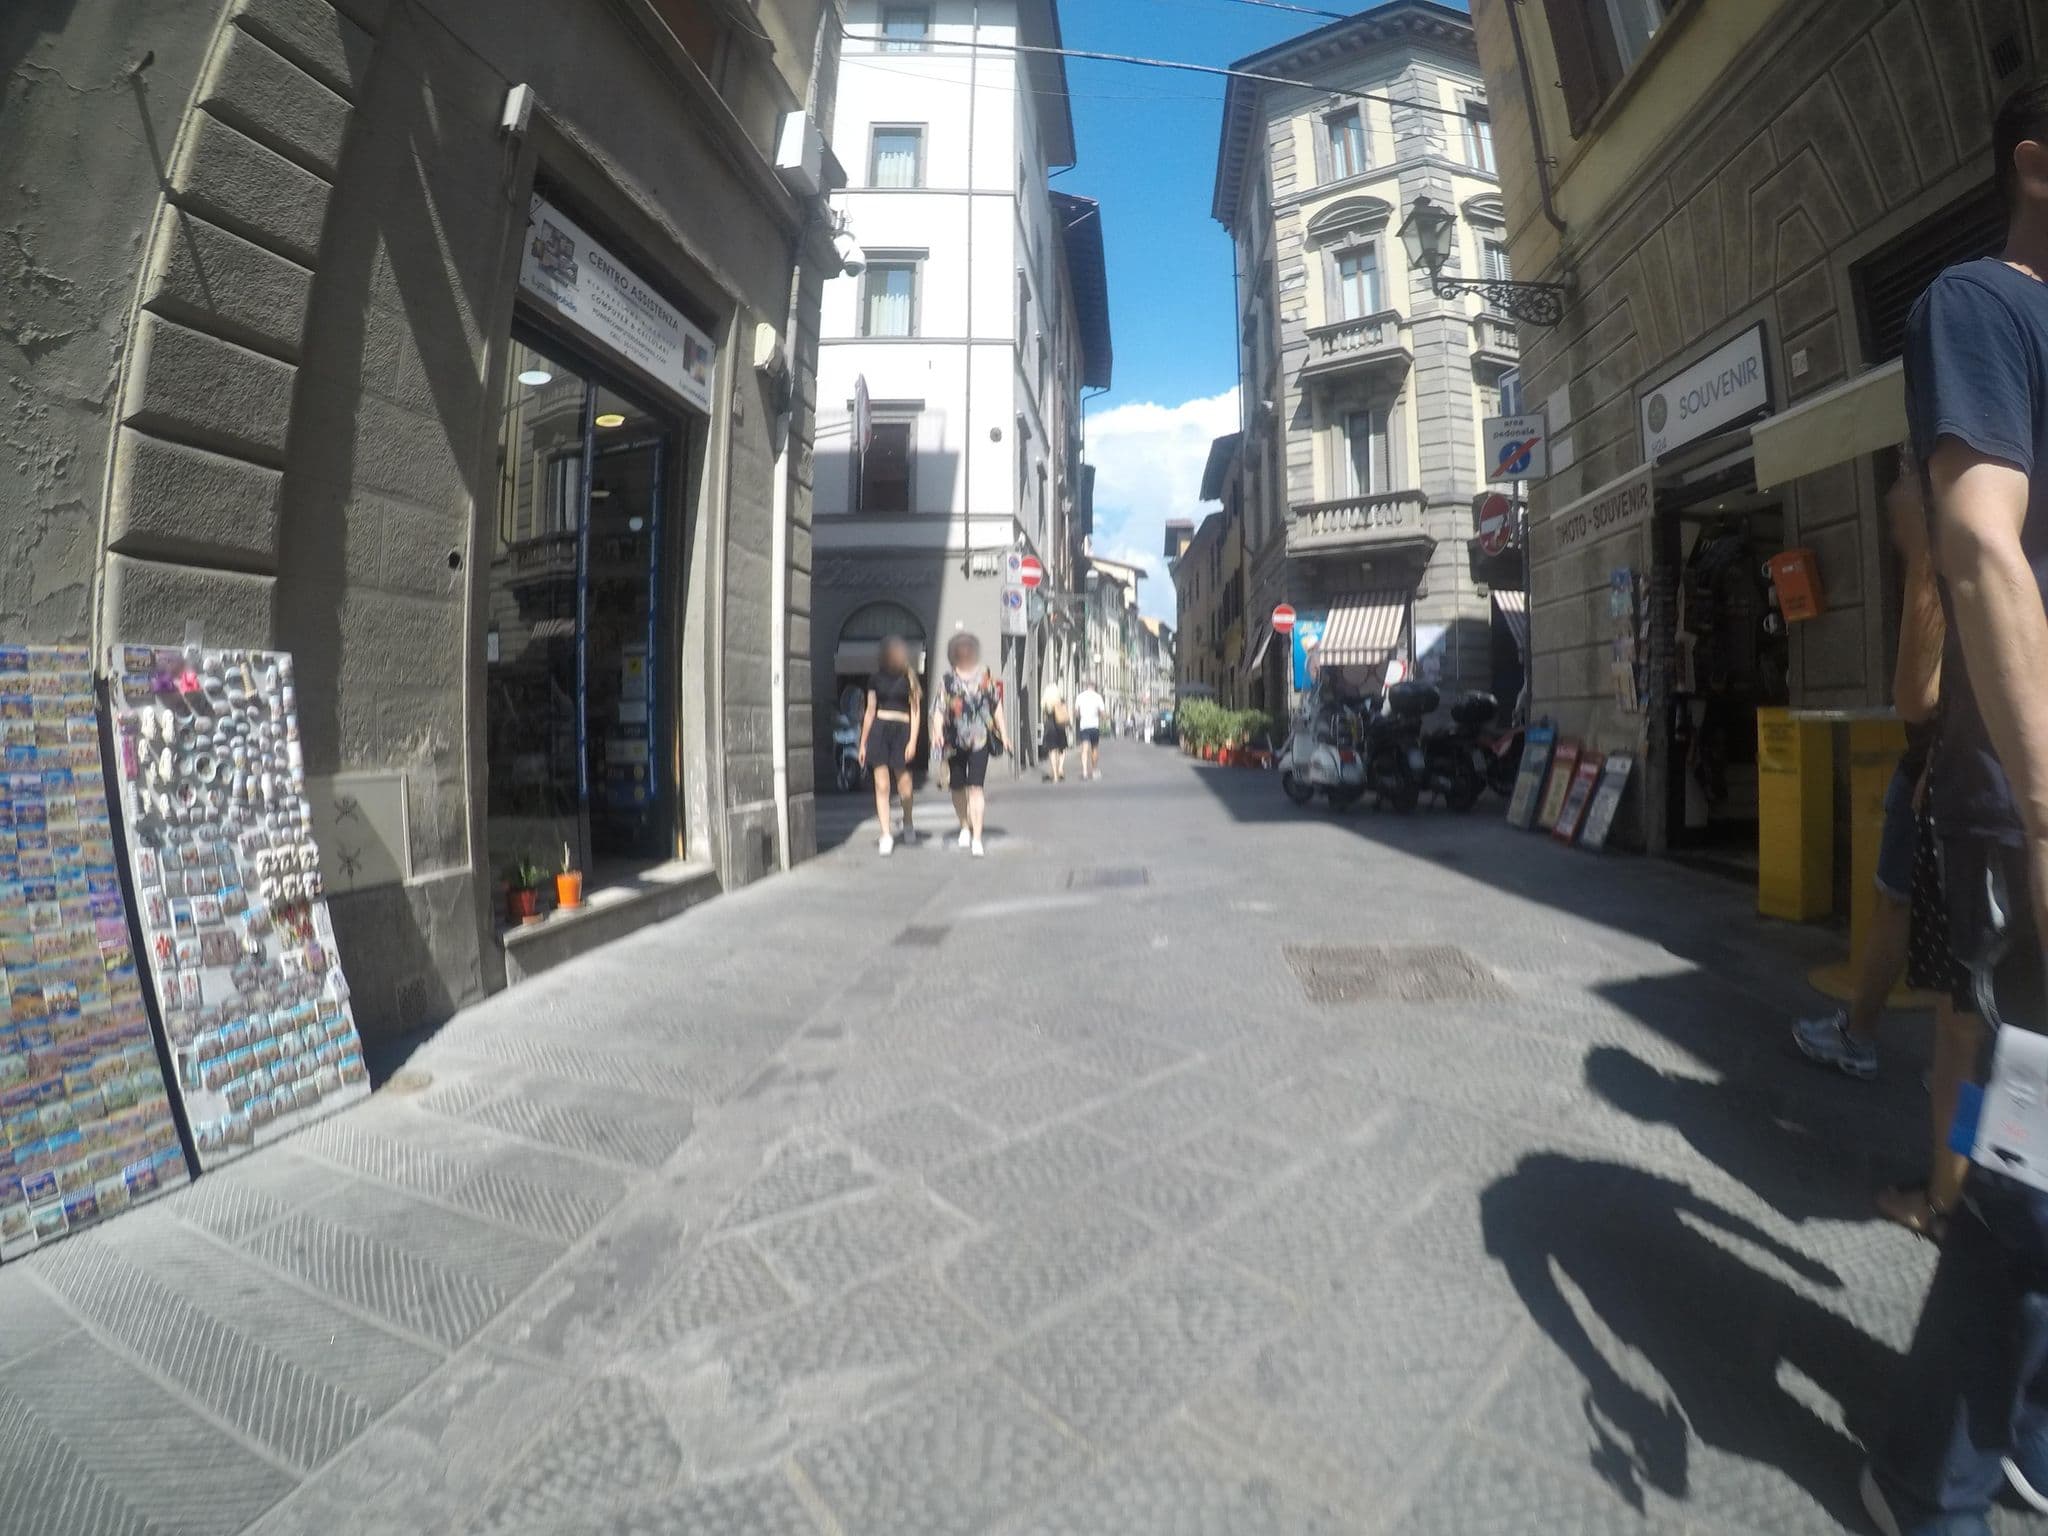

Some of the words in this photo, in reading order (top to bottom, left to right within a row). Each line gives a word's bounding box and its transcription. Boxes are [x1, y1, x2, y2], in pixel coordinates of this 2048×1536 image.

[588, 251, 629, 289] CENTRO
[630, 286, 679, 329] ASSISTENZA
[1679, 356, 1760, 421] SOUVENIR
[1493, 427, 1536, 440] pedonale
[1503, 418, 1524, 428] area
[1593, 482, 1648, 529] SOUVENIR
